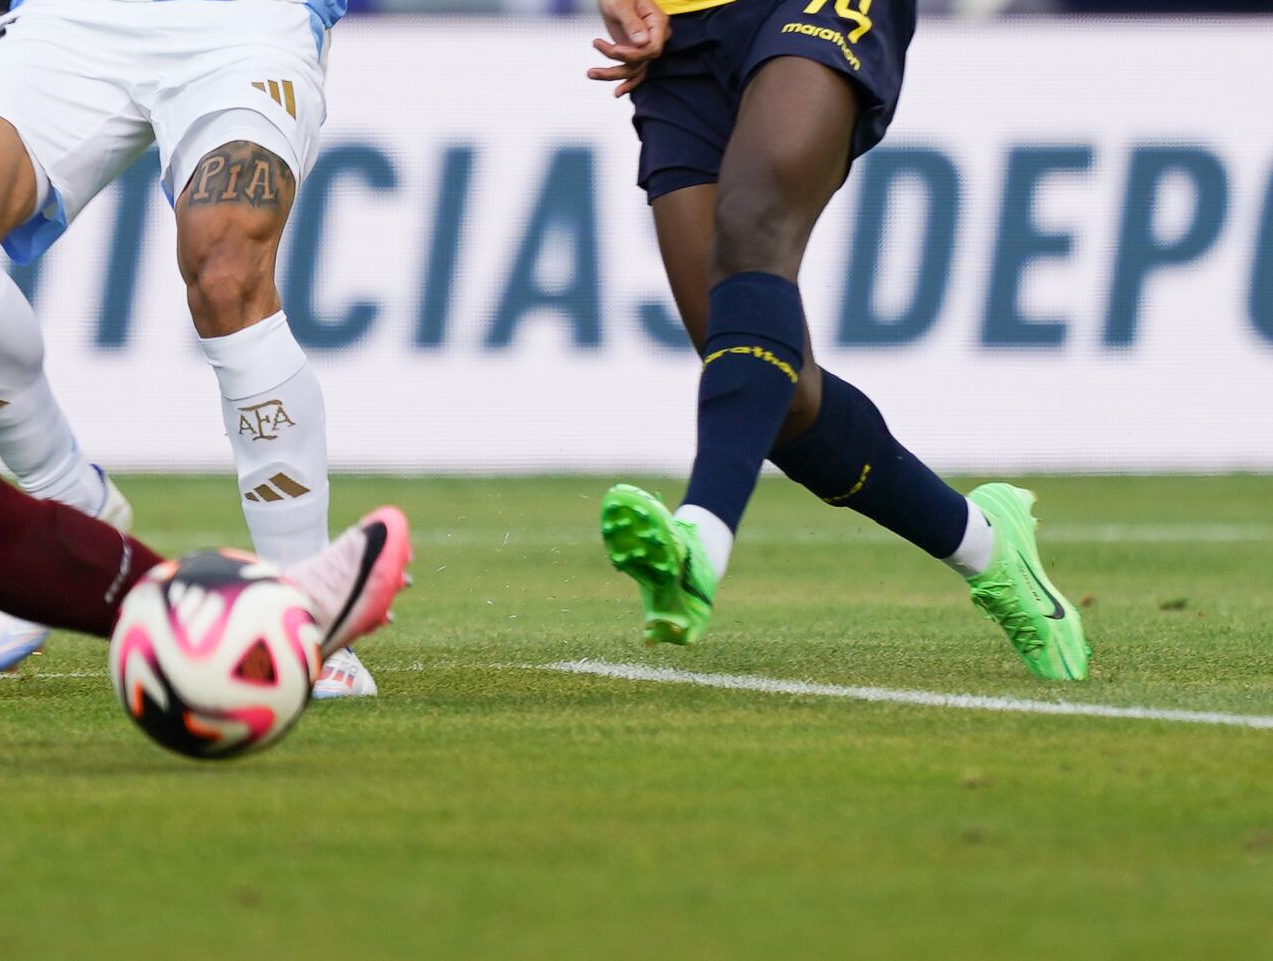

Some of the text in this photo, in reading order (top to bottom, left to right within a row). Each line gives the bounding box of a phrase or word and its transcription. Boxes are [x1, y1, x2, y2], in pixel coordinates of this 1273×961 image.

[781, 21, 861, 71] marathon
[192, 155, 277, 201] PIA
[237, 399, 297, 441] AFA
